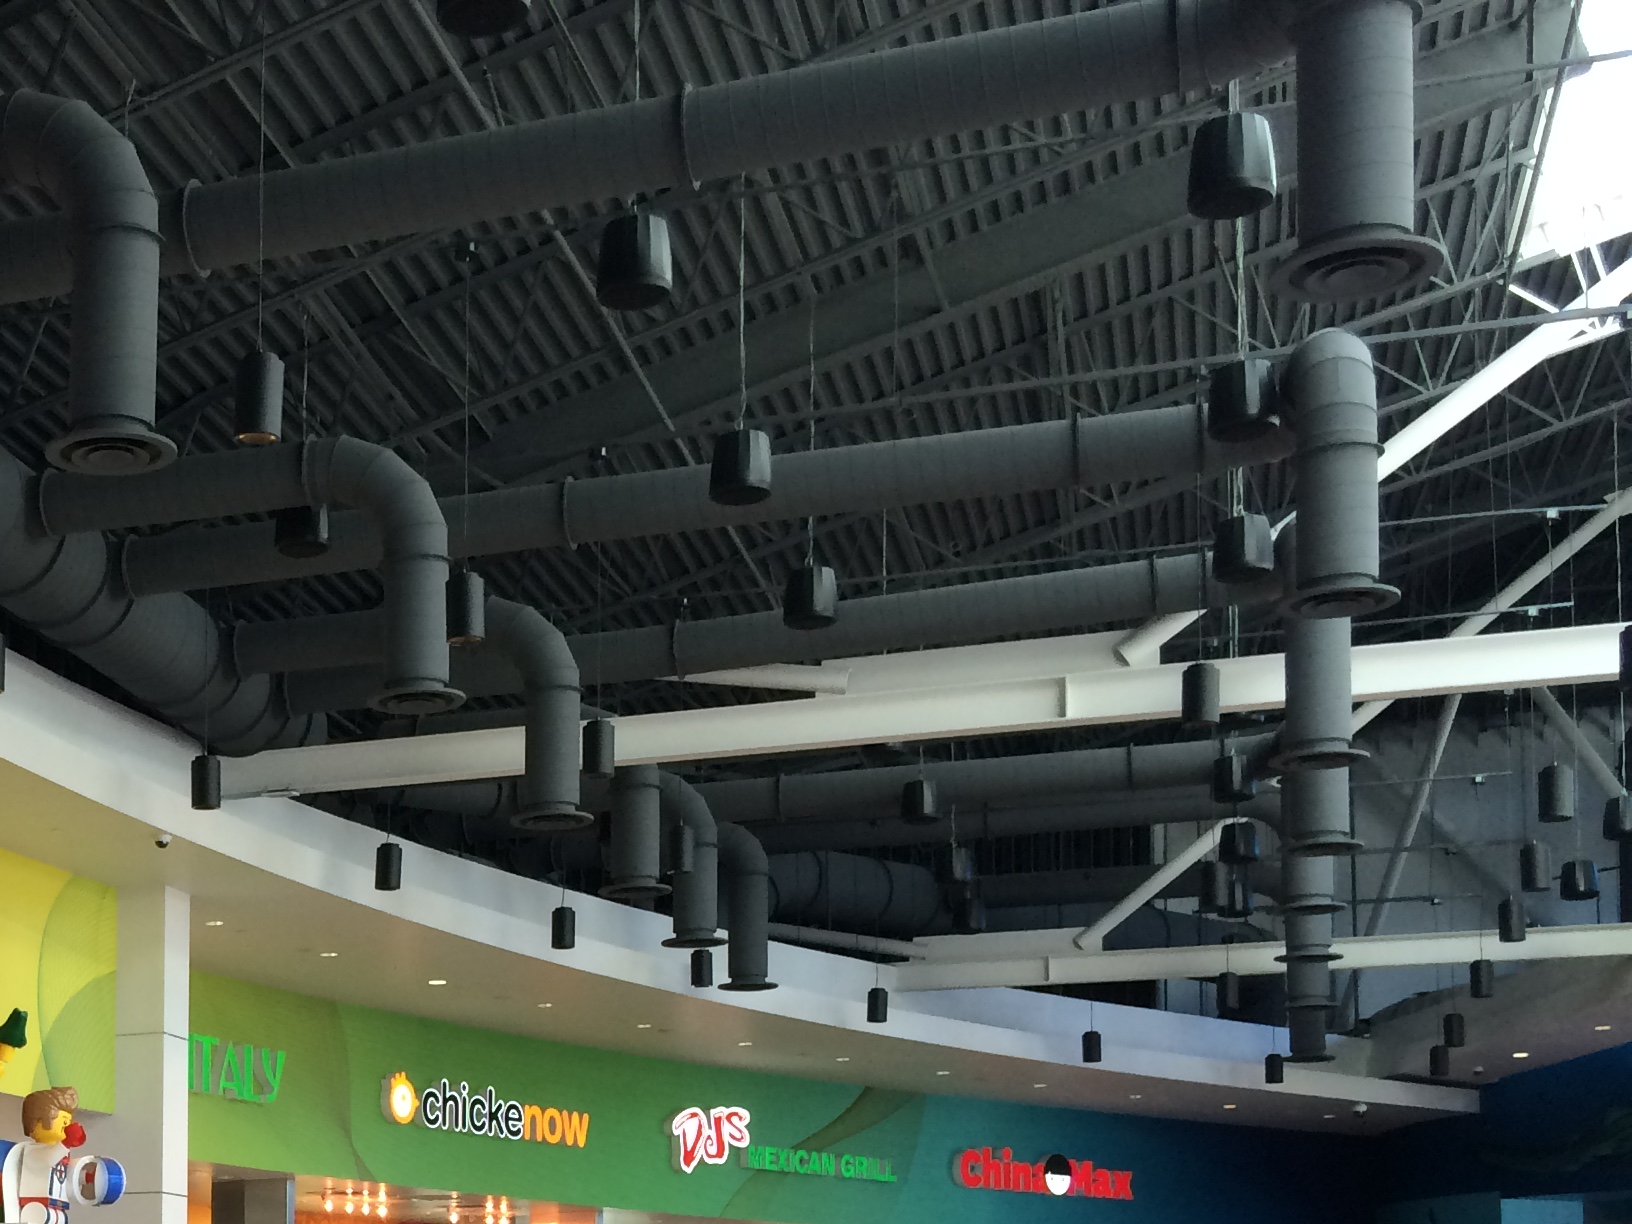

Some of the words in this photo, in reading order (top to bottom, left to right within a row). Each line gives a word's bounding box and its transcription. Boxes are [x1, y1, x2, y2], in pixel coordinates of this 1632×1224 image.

[747, 1144, 836, 1176] MEXICAN
[840, 1153, 898, 1182] GRILL
[959, 1146, 1051, 1195] China
[1068, 1159, 1134, 1201] Max
